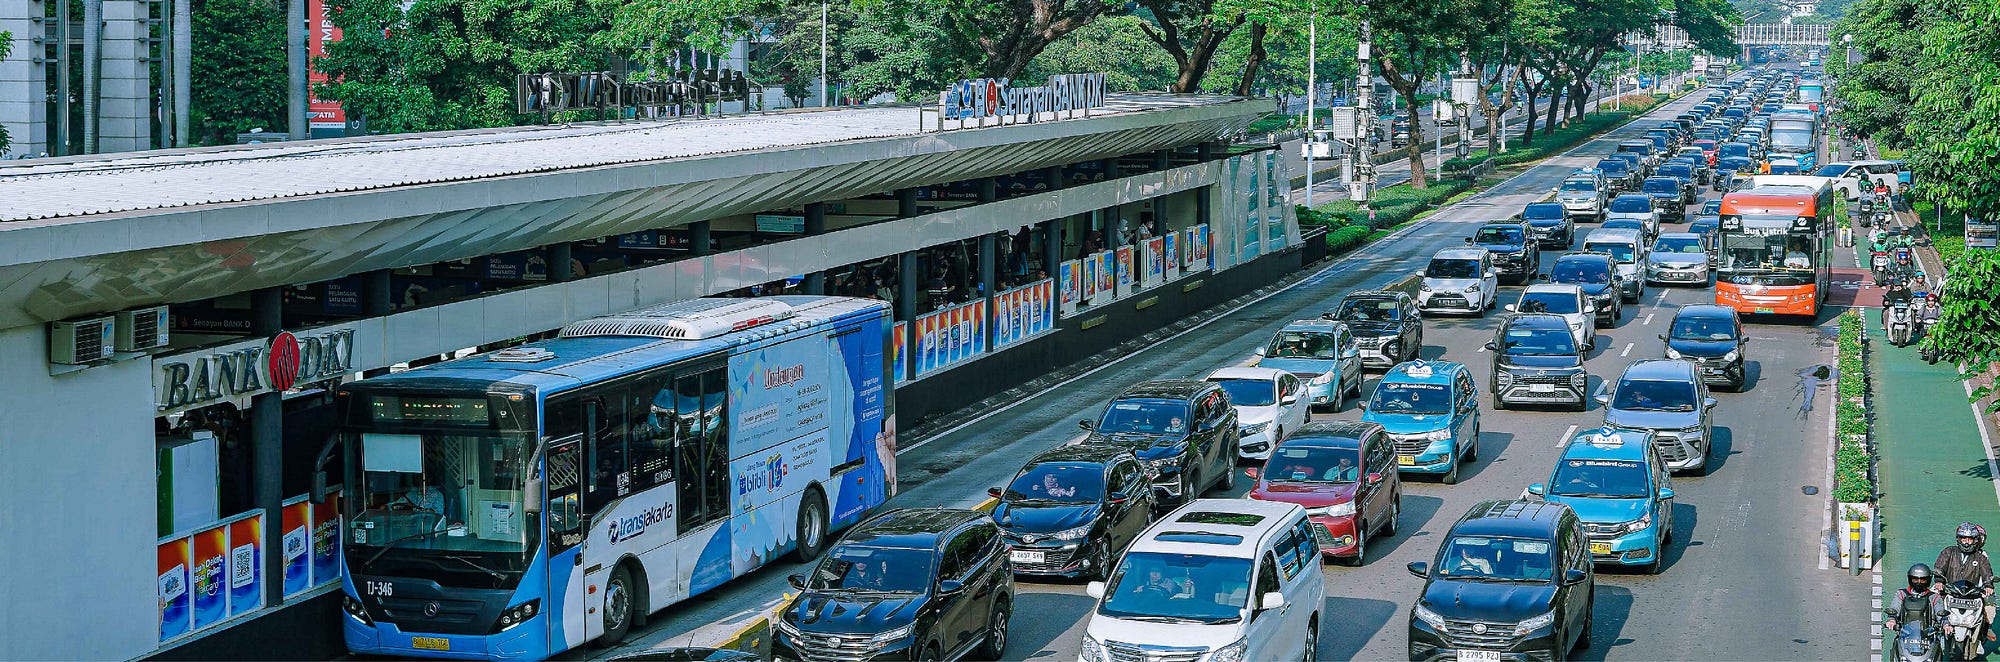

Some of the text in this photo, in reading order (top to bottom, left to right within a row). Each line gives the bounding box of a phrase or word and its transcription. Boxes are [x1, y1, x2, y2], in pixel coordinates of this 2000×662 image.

[1000, 77, 1053, 124] Senayan
[1053, 74, 1086, 113] BANK
[1086, 72, 1107, 110] DKI
[193, 318, 222, 328] Senayan
[224, 320, 243, 328] BANK
[159, 329, 356, 410] BANK DKI
[764, 363, 804, 391] Undangan
[746, 470, 766, 493] blibli
[620, 501, 673, 542] transjakarta
[367, 581, 393, 596] TJ-346
[1466, 651, 1483, 659] 2795
